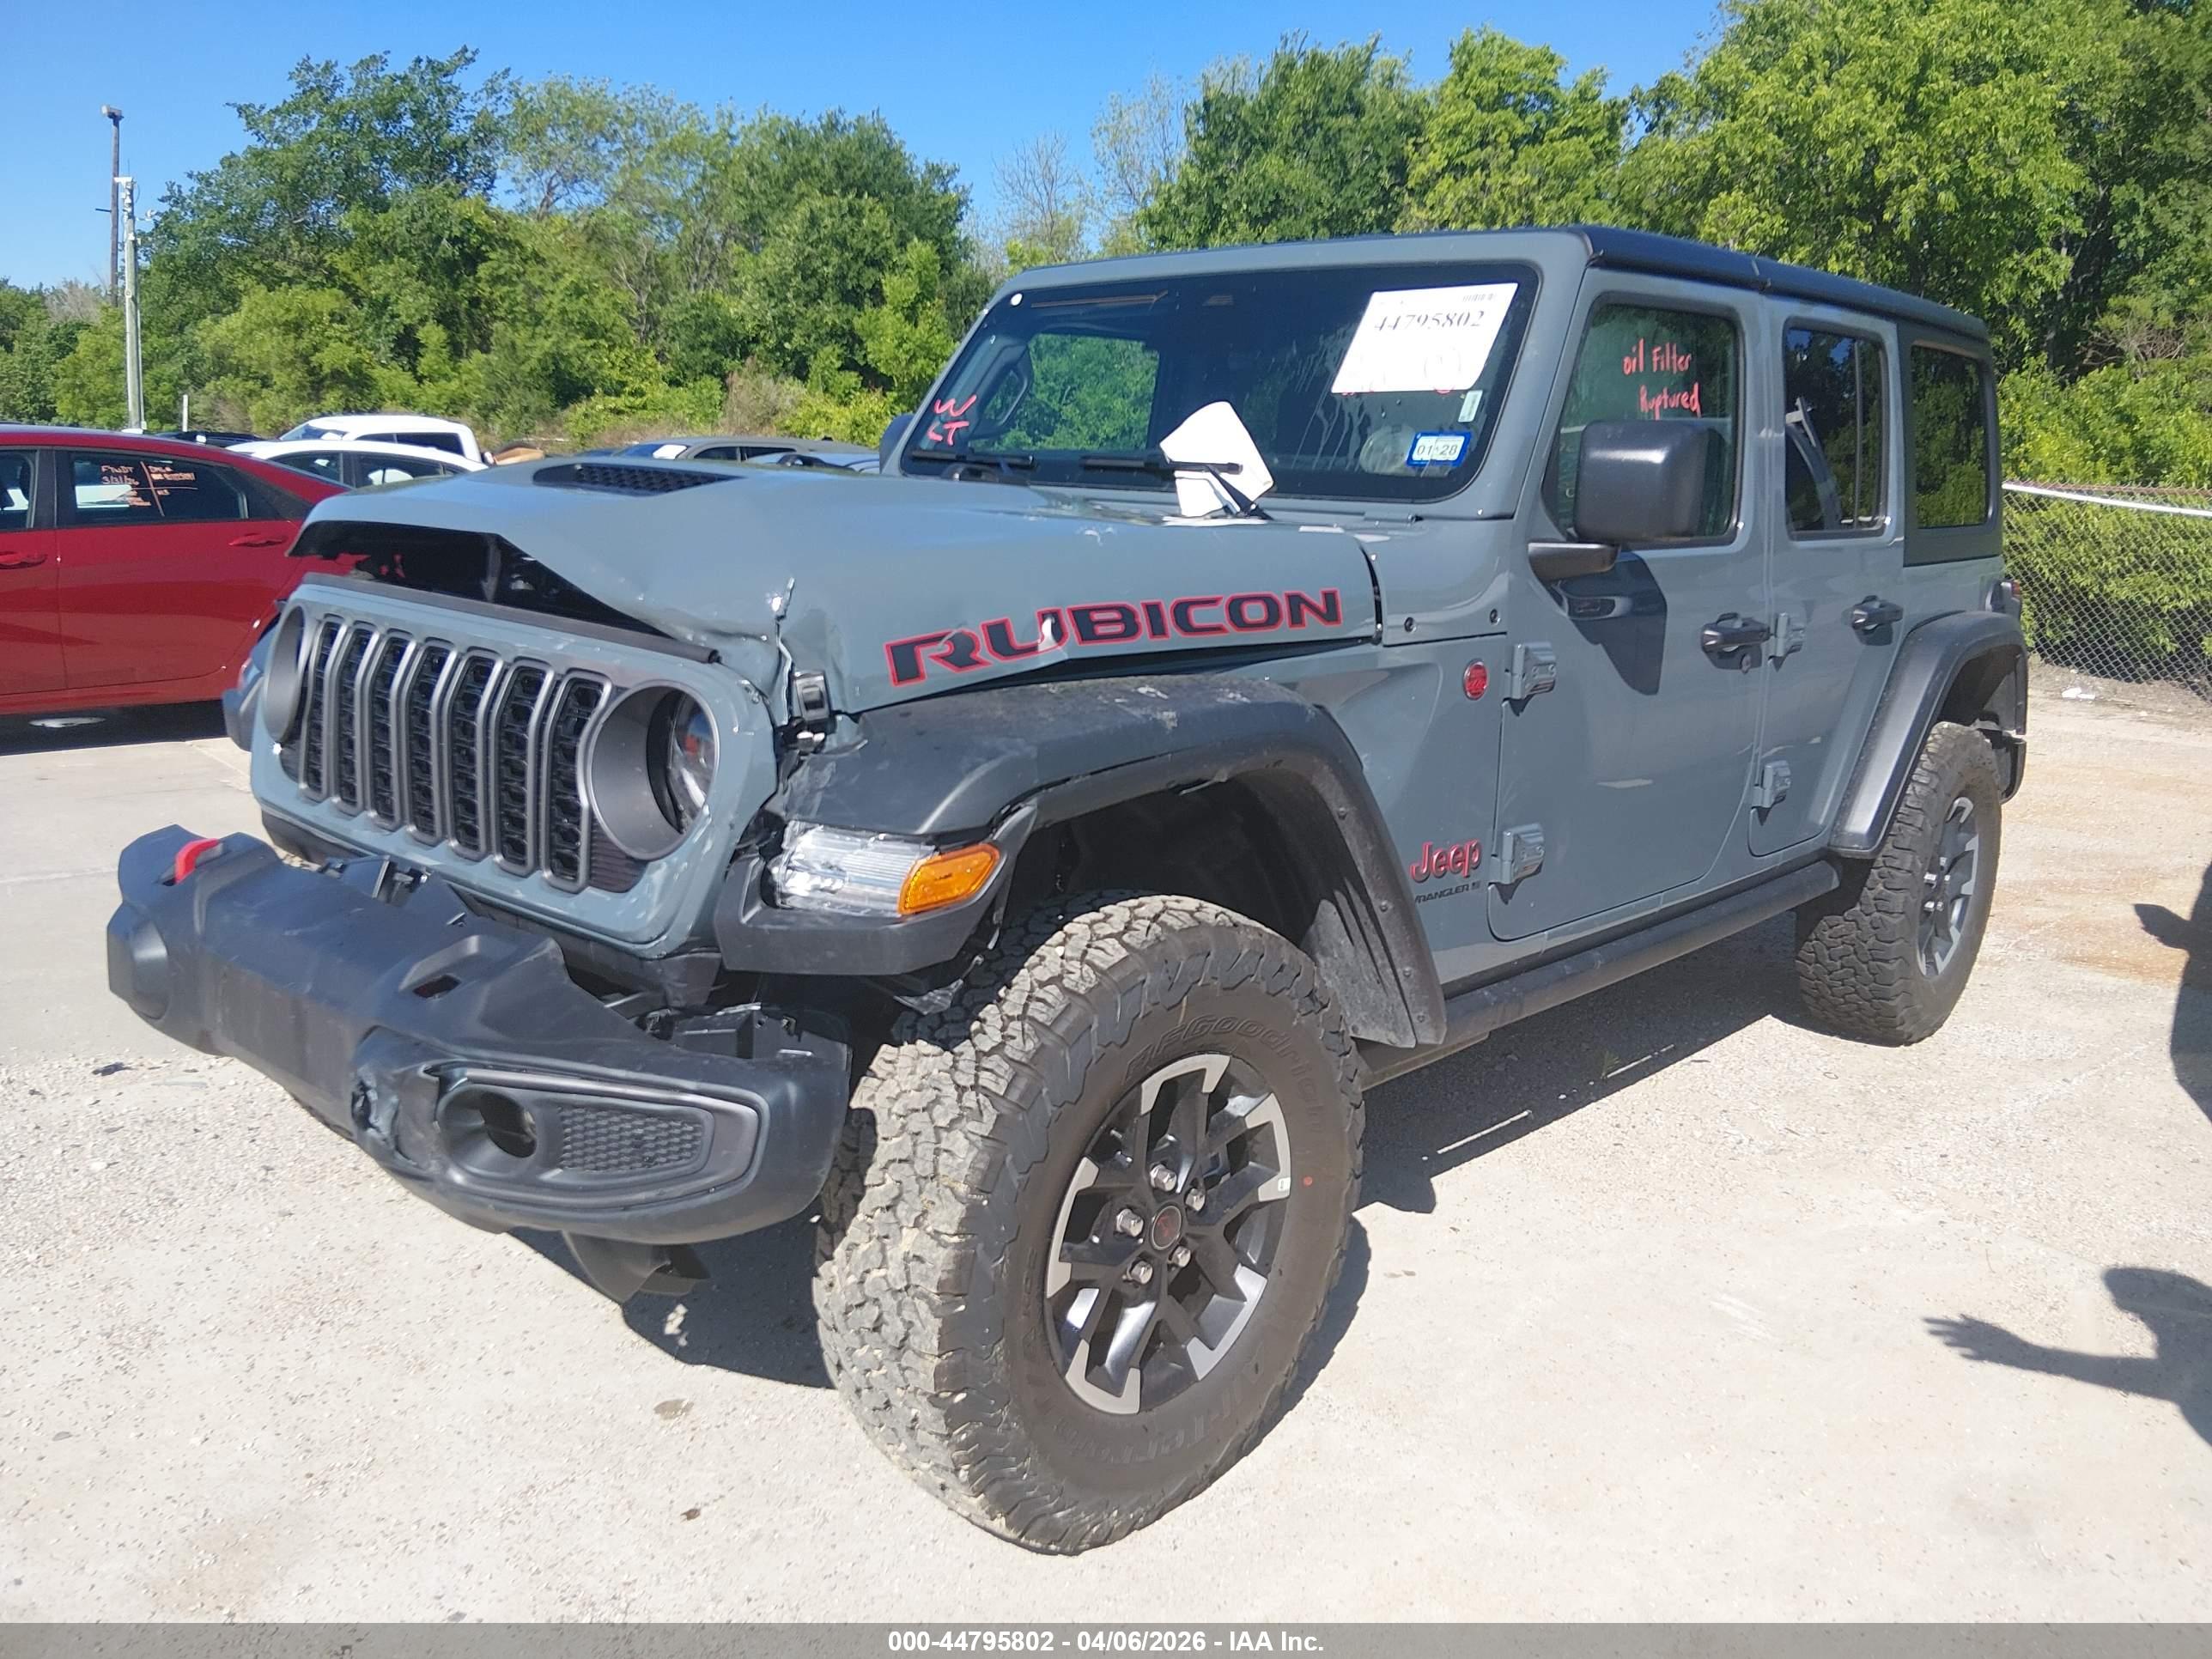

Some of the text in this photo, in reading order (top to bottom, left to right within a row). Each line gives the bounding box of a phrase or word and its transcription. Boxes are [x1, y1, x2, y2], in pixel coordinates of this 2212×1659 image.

[1373, 309, 1486, 331] 44795802
[1622, 337, 1644, 375] oil
[884, 587, 1344, 687] RUBICON
[1410, 839, 1481, 883] Jeep
